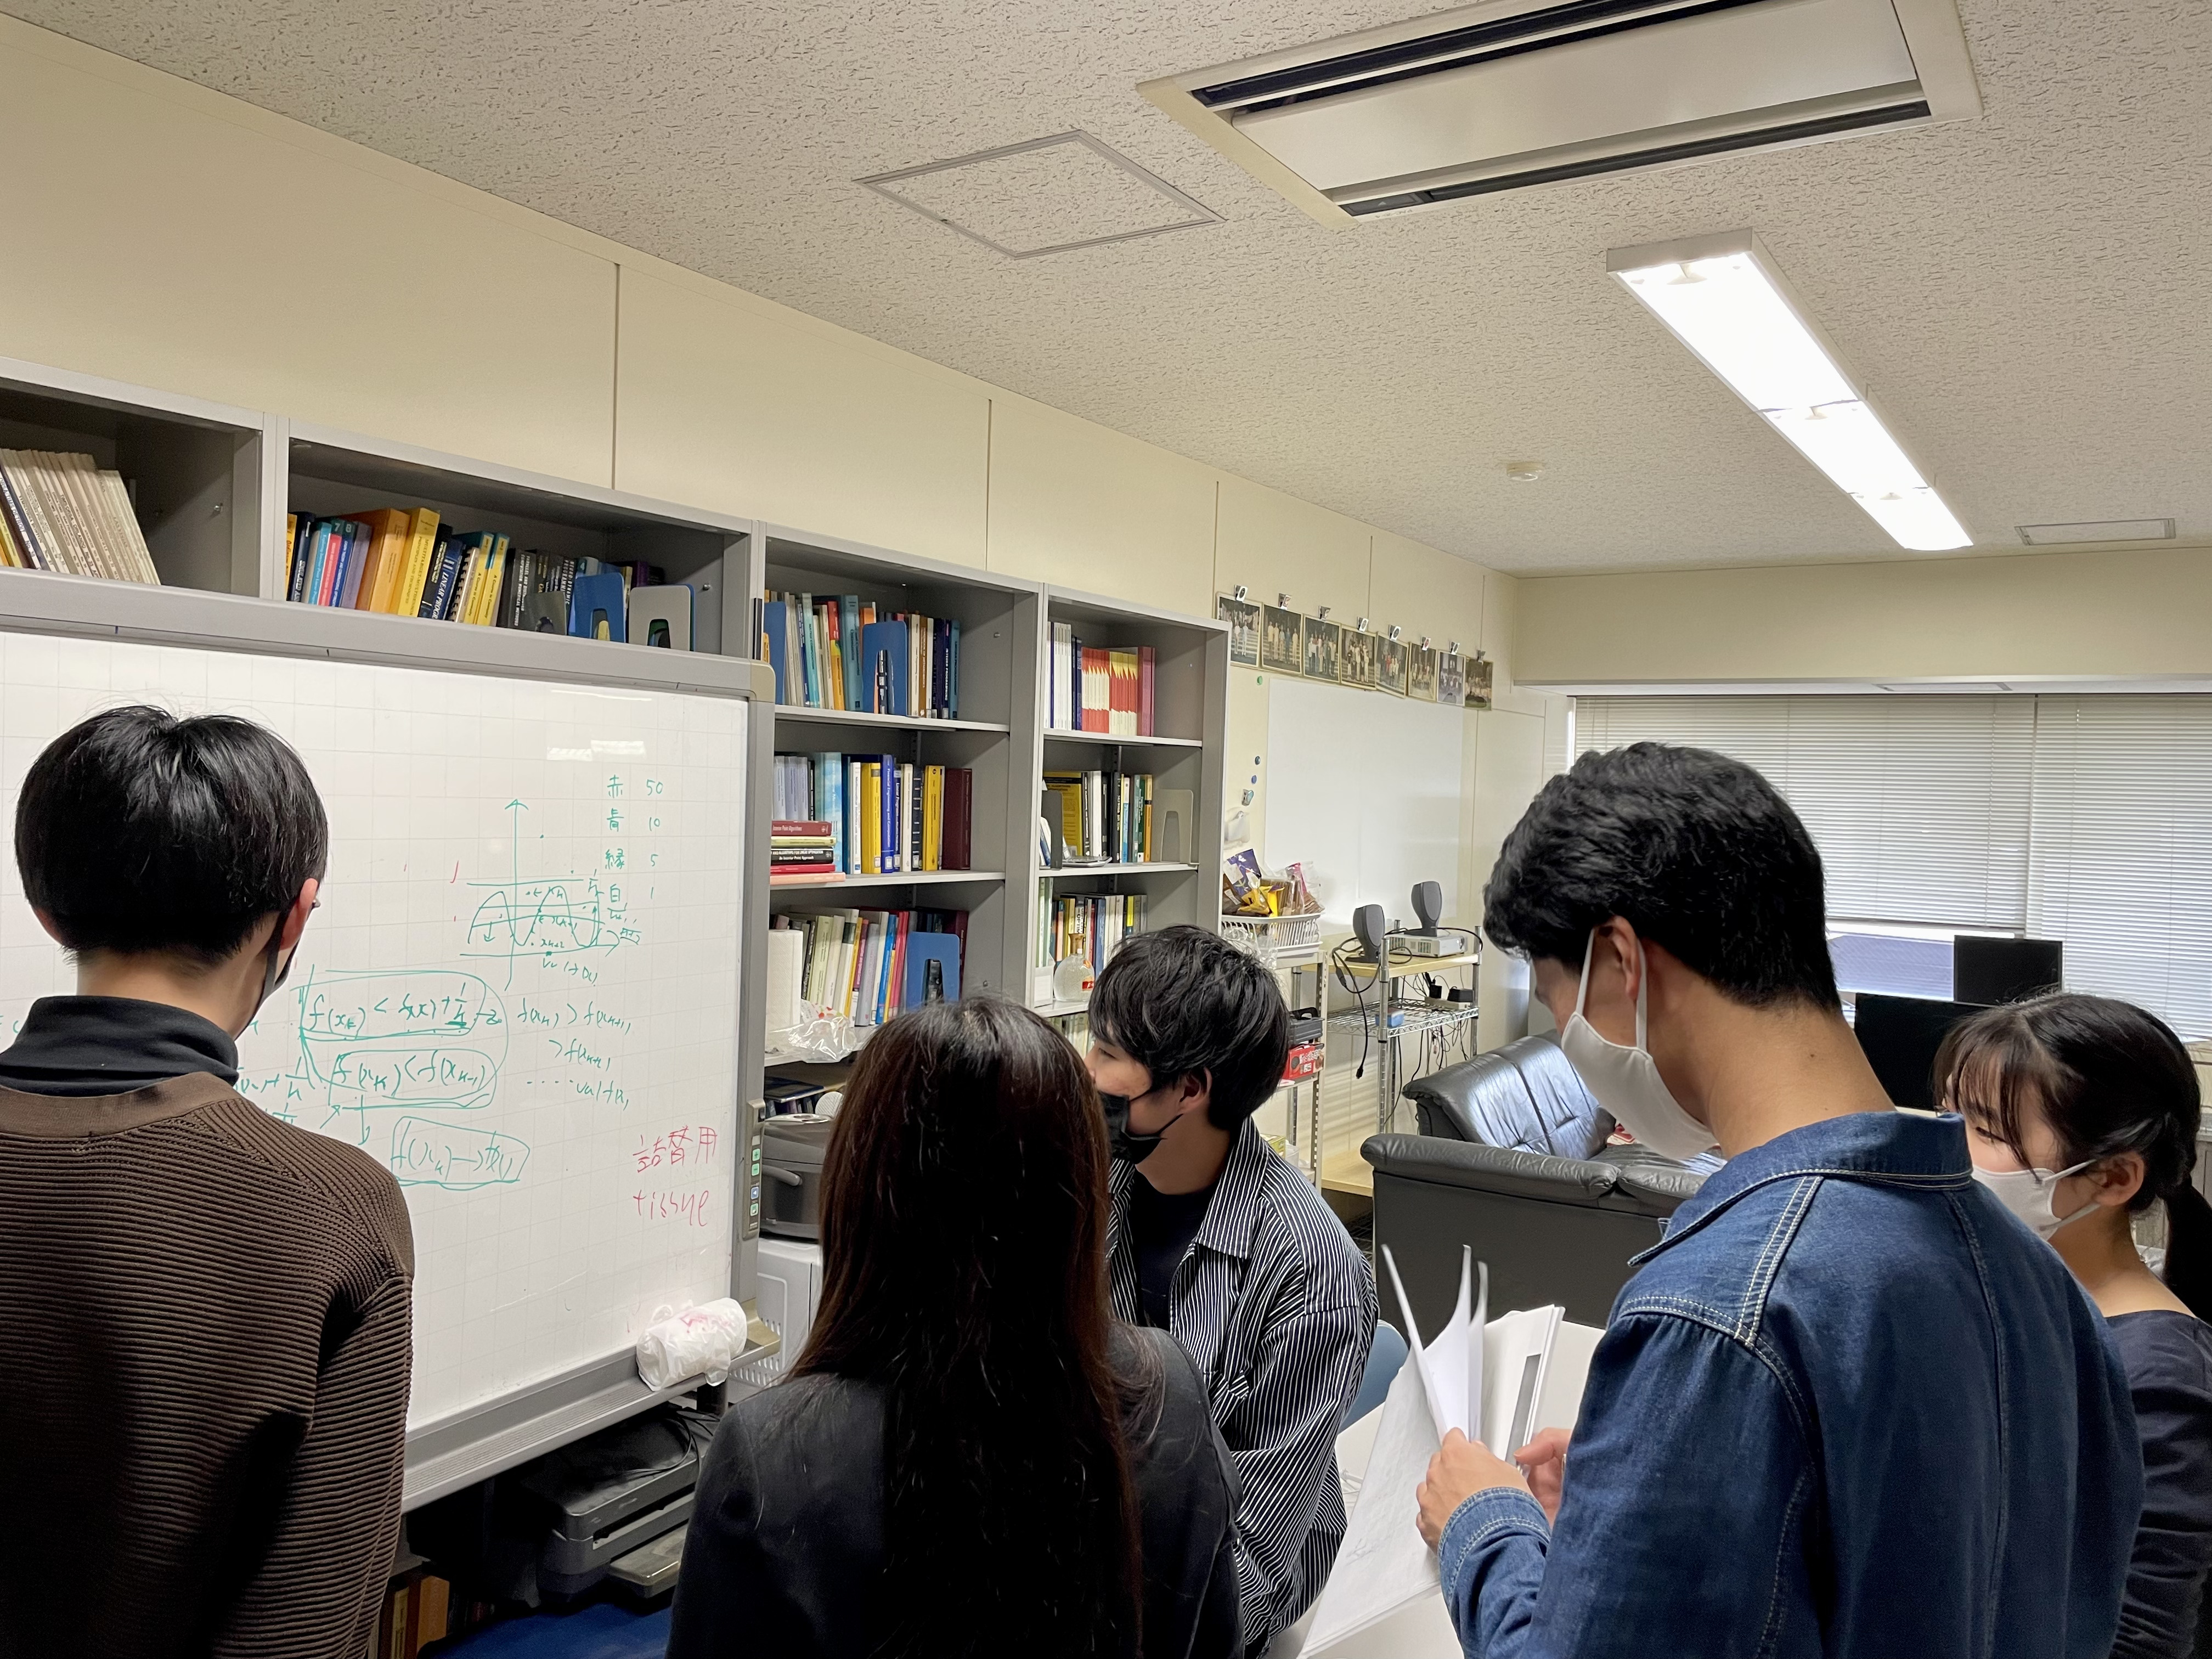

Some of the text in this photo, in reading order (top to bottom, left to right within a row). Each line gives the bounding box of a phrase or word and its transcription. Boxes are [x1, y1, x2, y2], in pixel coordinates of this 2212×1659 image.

[437, 571, 448, 596] LINEAR
[607, 774, 624, 798] 赤
[646, 779, 663, 795] 50
[607, 808, 624, 832] 青
[649, 817, 661, 831] 10
[651, 854, 658, 867] 5
[633, 1125, 718, 1173] 詰替用
[633, 1189, 709, 1227] tissue
